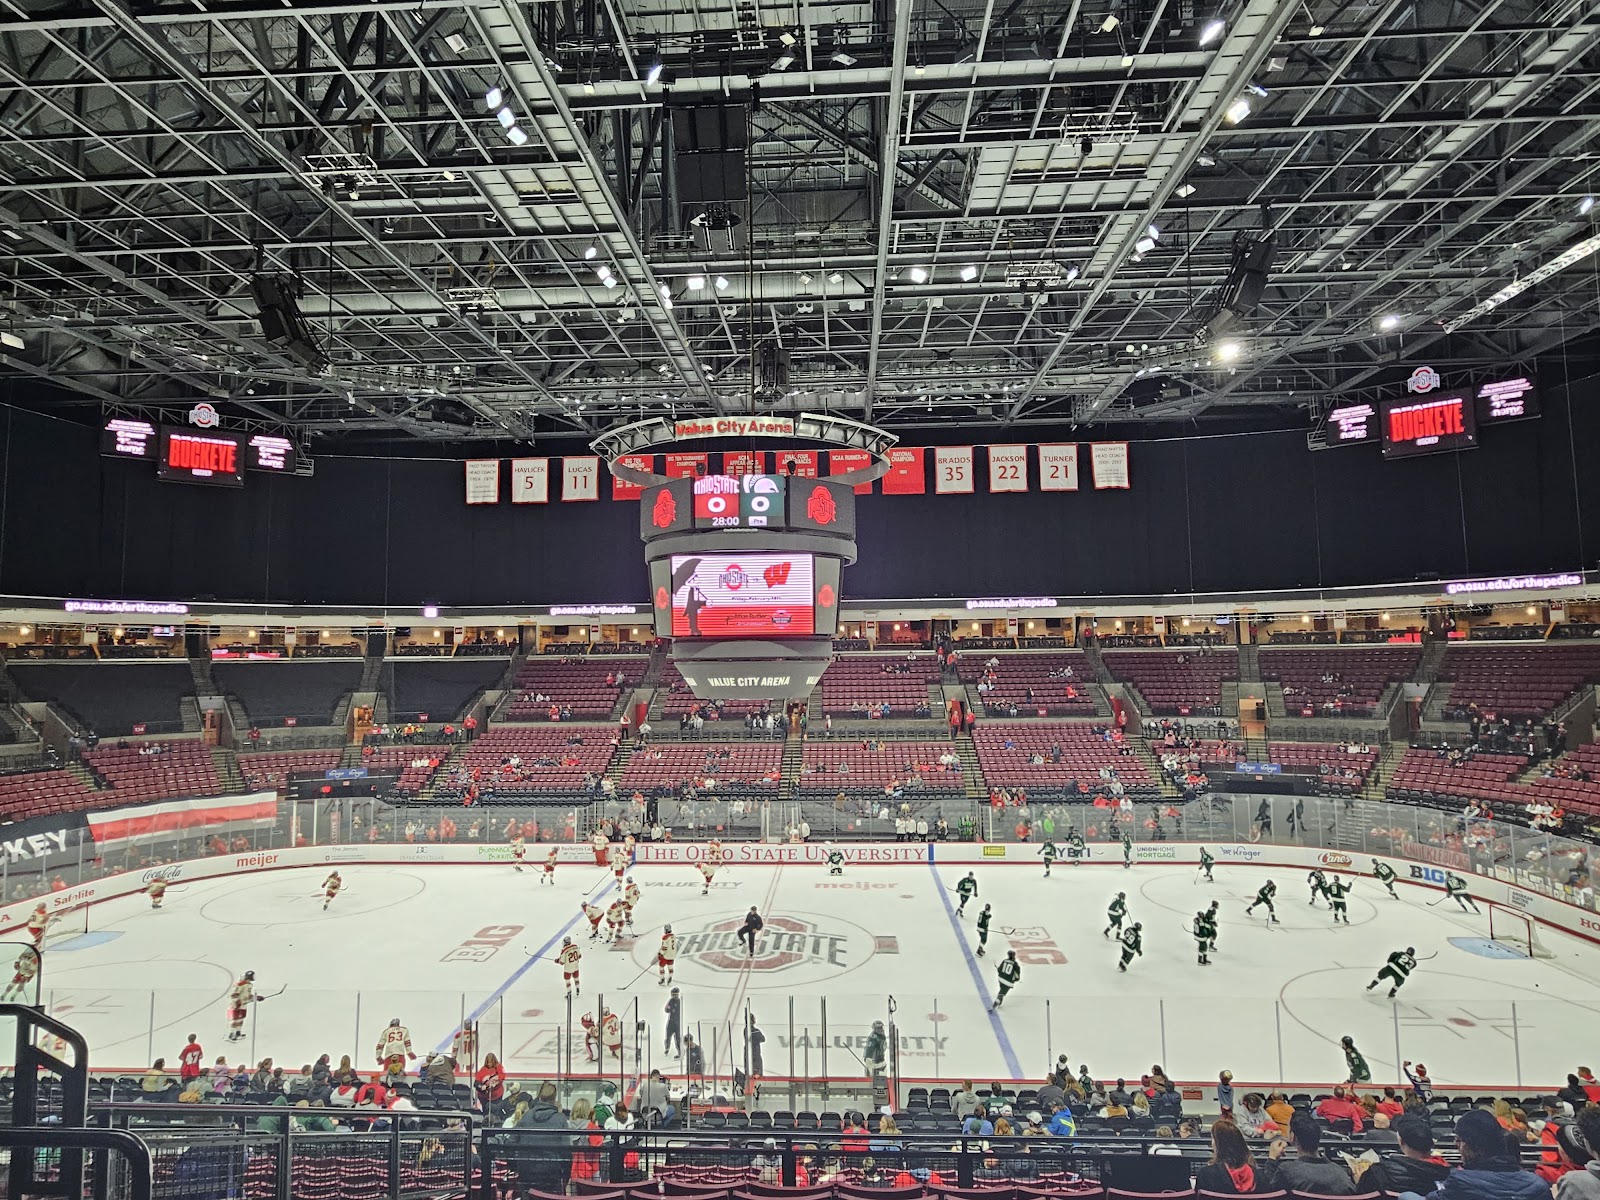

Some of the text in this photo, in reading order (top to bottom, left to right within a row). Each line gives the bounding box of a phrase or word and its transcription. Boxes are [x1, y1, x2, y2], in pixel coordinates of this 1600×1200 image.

[675, 421, 792, 436] Value City Arena
[1391, 404, 1464, 442] BUCKEYE
[169, 439, 236, 473] BUCKEYE
[945, 467, 964, 481] 35
[998, 465, 1020, 479] 22
[1050, 465, 1068, 478] 21
[525, 476, 534, 490] 5
[573, 475, 588, 490] 11
[708, 497, 726, 512] 0
[751, 496, 770, 512] 0
[712, 516, 740, 526] 28:00
[708, 677, 736, 687] VALUE
[737, 677, 759, 687] CITY
[760, 676, 791, 686] ARENA
[641, 845, 926, 860] THE OHO STATE UNVERSITY
[1233, 846, 1261, 860] Kroger
[236, 853, 279, 868] meijer
[815, 881, 898, 890] meijer
[54, 889, 95, 907] Safelite
[568, 951, 579, 963] 20
[1397, 954, 1414, 970] 23
[1001, 962, 1013, 974] 10
[388, 1031, 403, 1043] 63
[777, 1035, 870, 1049] VALUE
[186, 1051, 198, 1064] 47
